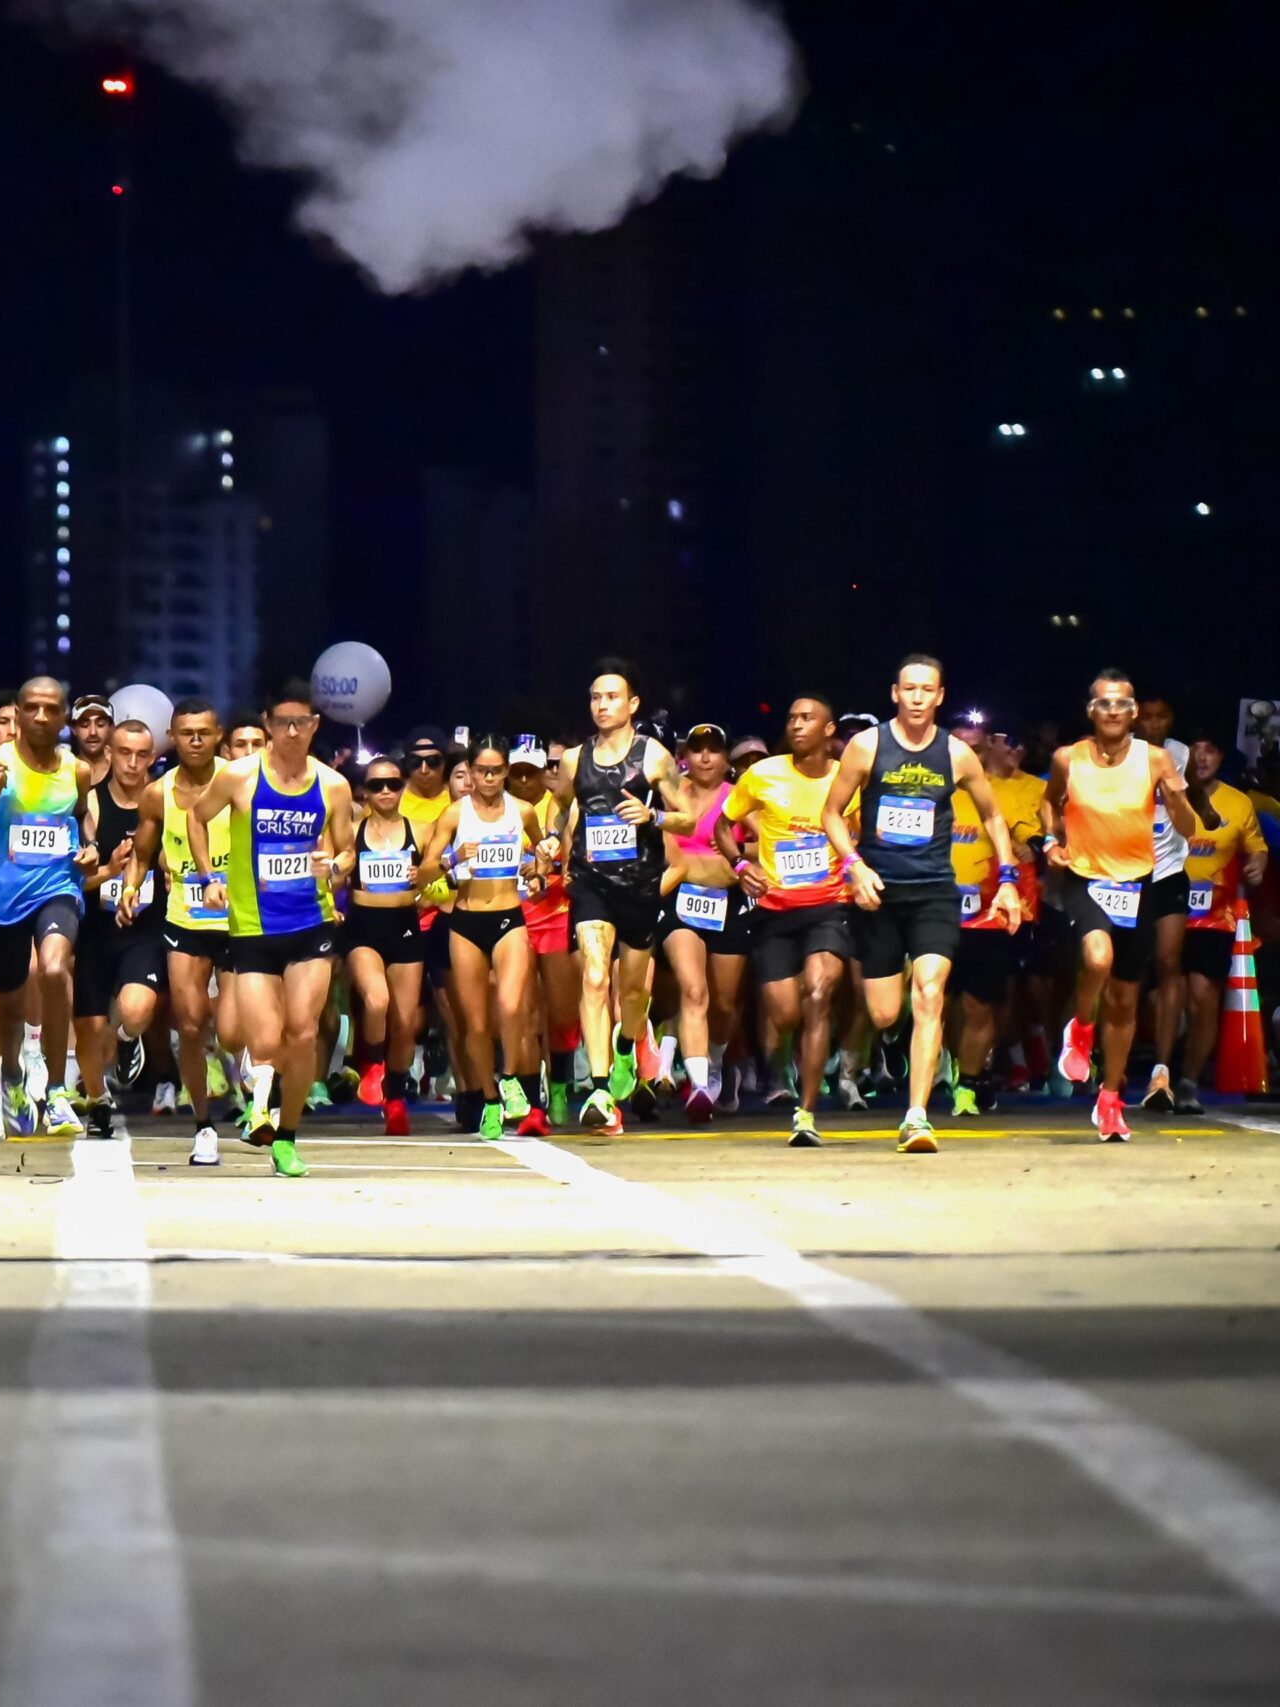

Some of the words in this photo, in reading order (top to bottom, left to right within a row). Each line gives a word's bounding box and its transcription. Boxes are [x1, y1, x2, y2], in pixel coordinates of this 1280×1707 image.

[272, 808, 317, 824] TEAM
[256, 820, 314, 836] CRISTAL
[592, 828, 628, 845] 10222
[21, 829, 56, 848] 9129
[268, 856, 308, 875] 10221
[781, 851, 821, 870] 10076
[368, 863, 403, 879] 10102
[686, 896, 716, 915] 9091
